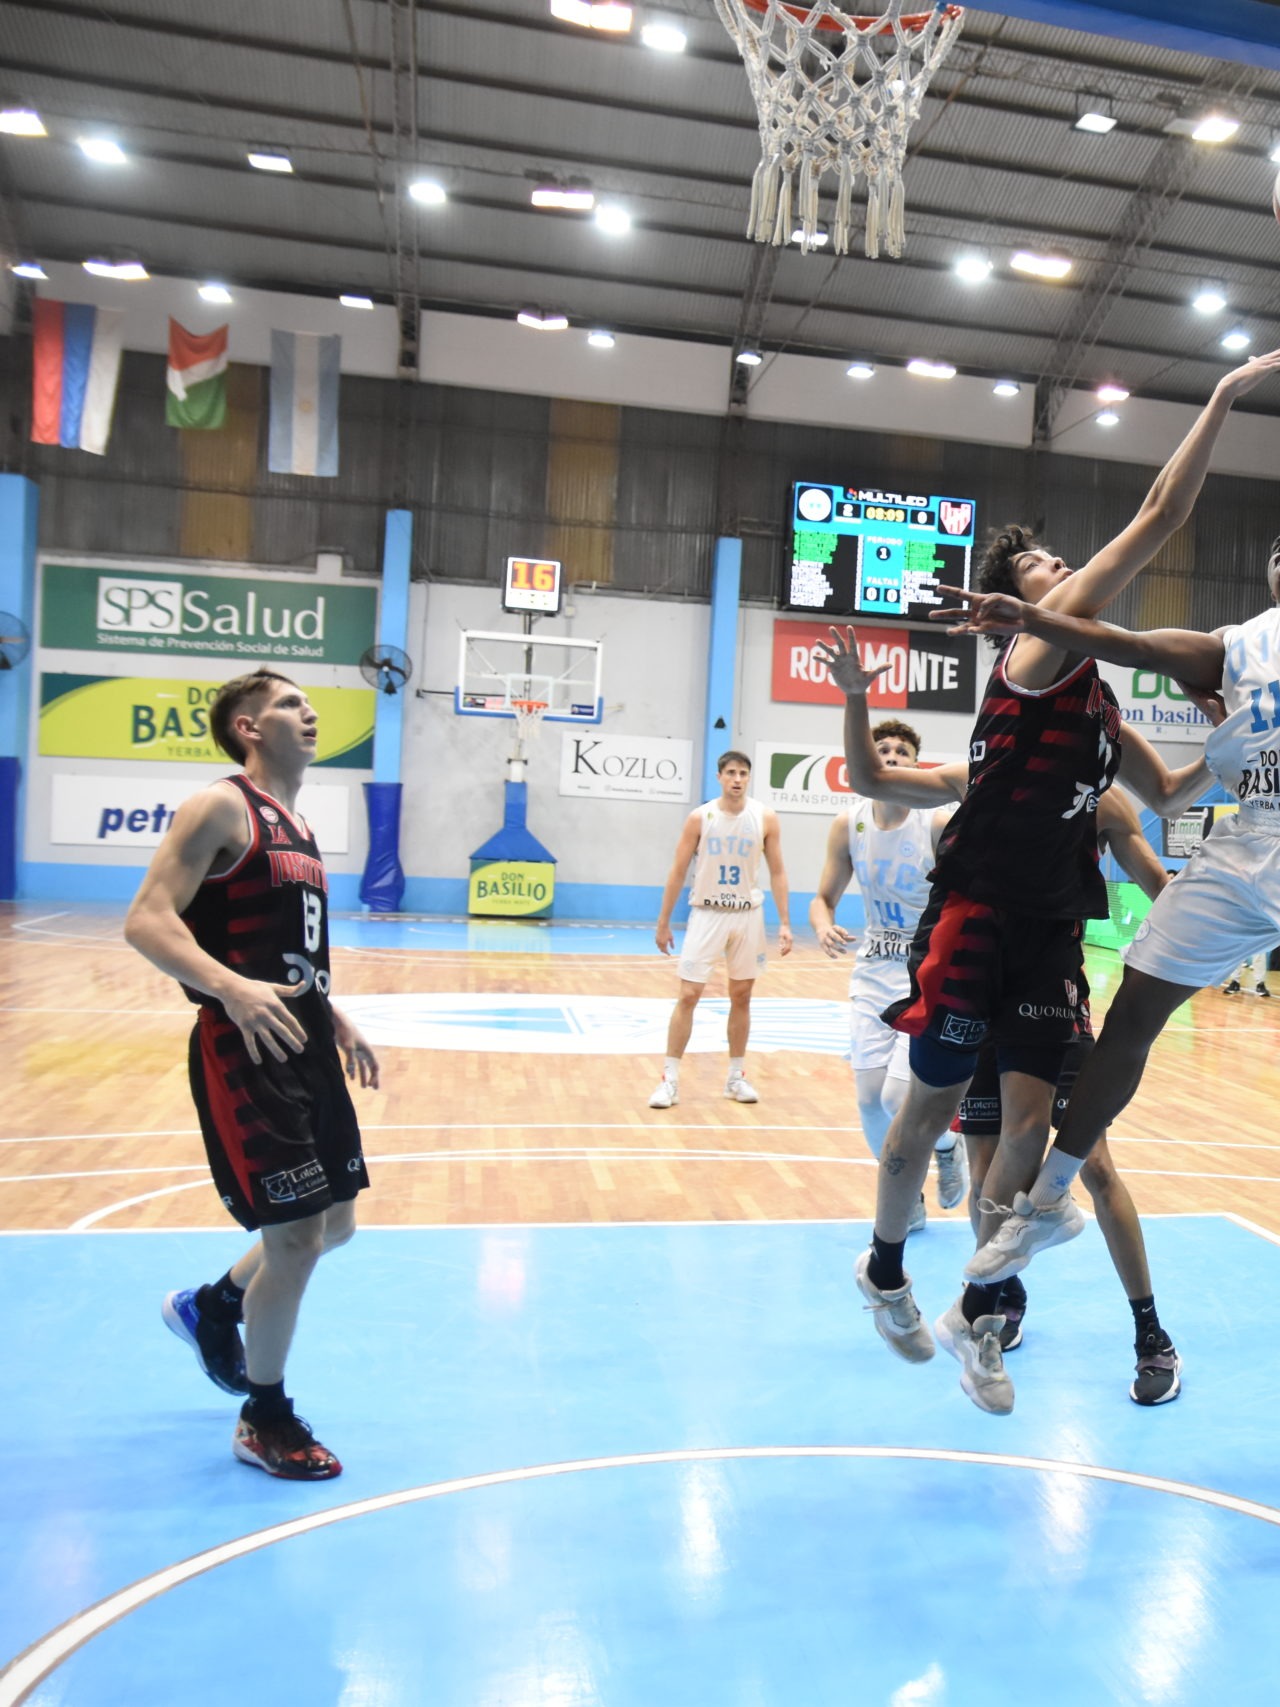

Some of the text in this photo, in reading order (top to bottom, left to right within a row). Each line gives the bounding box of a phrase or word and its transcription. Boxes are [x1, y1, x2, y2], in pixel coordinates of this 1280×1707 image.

[858, 490, 928, 507] MULTILED
[843, 504, 927, 524] 2 08:09 0
[879, 547, 888, 559] 1
[512, 560, 555, 592] 16
[866, 576, 899, 586] FALTAS
[866, 587, 898, 602] 0 0
[103, 585, 326, 640] SPS Salud
[96, 633, 324, 657] Sistema de Prevención Social de Salud
[790, 642, 959, 694] ROMONTE
[188, 687, 220, 705] DO
[1120, 708, 1144, 722] on
[167, 745, 212, 758] YERBA
[1249, 800, 1276, 811] YERBA
[501, 872, 524, 881] DON
[717, 864, 741, 885] 13
[477, 880, 546, 901] BASILIO
[720, 892, 737, 900] DON
[874, 899, 905, 929] 14
[865, 939, 910, 958] ASILI
